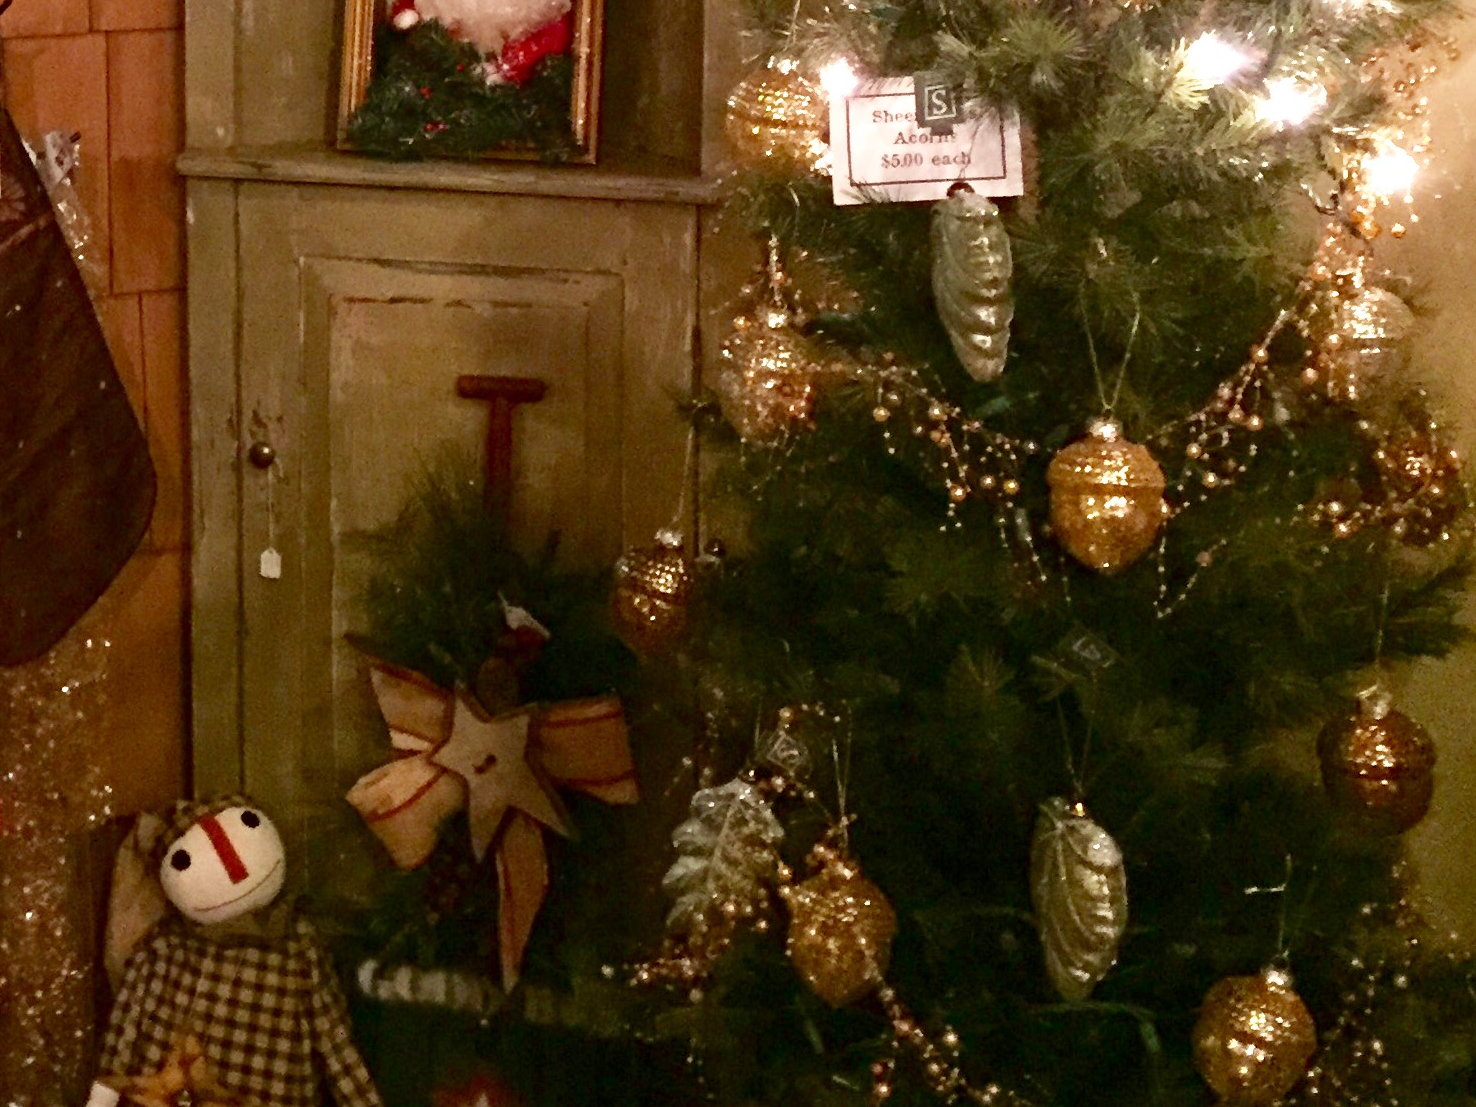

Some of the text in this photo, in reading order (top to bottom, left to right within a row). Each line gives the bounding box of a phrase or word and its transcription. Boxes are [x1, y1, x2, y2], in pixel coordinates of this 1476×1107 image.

[872, 110, 918, 125] Shee
[881, 151, 972, 170] $5.00 each
